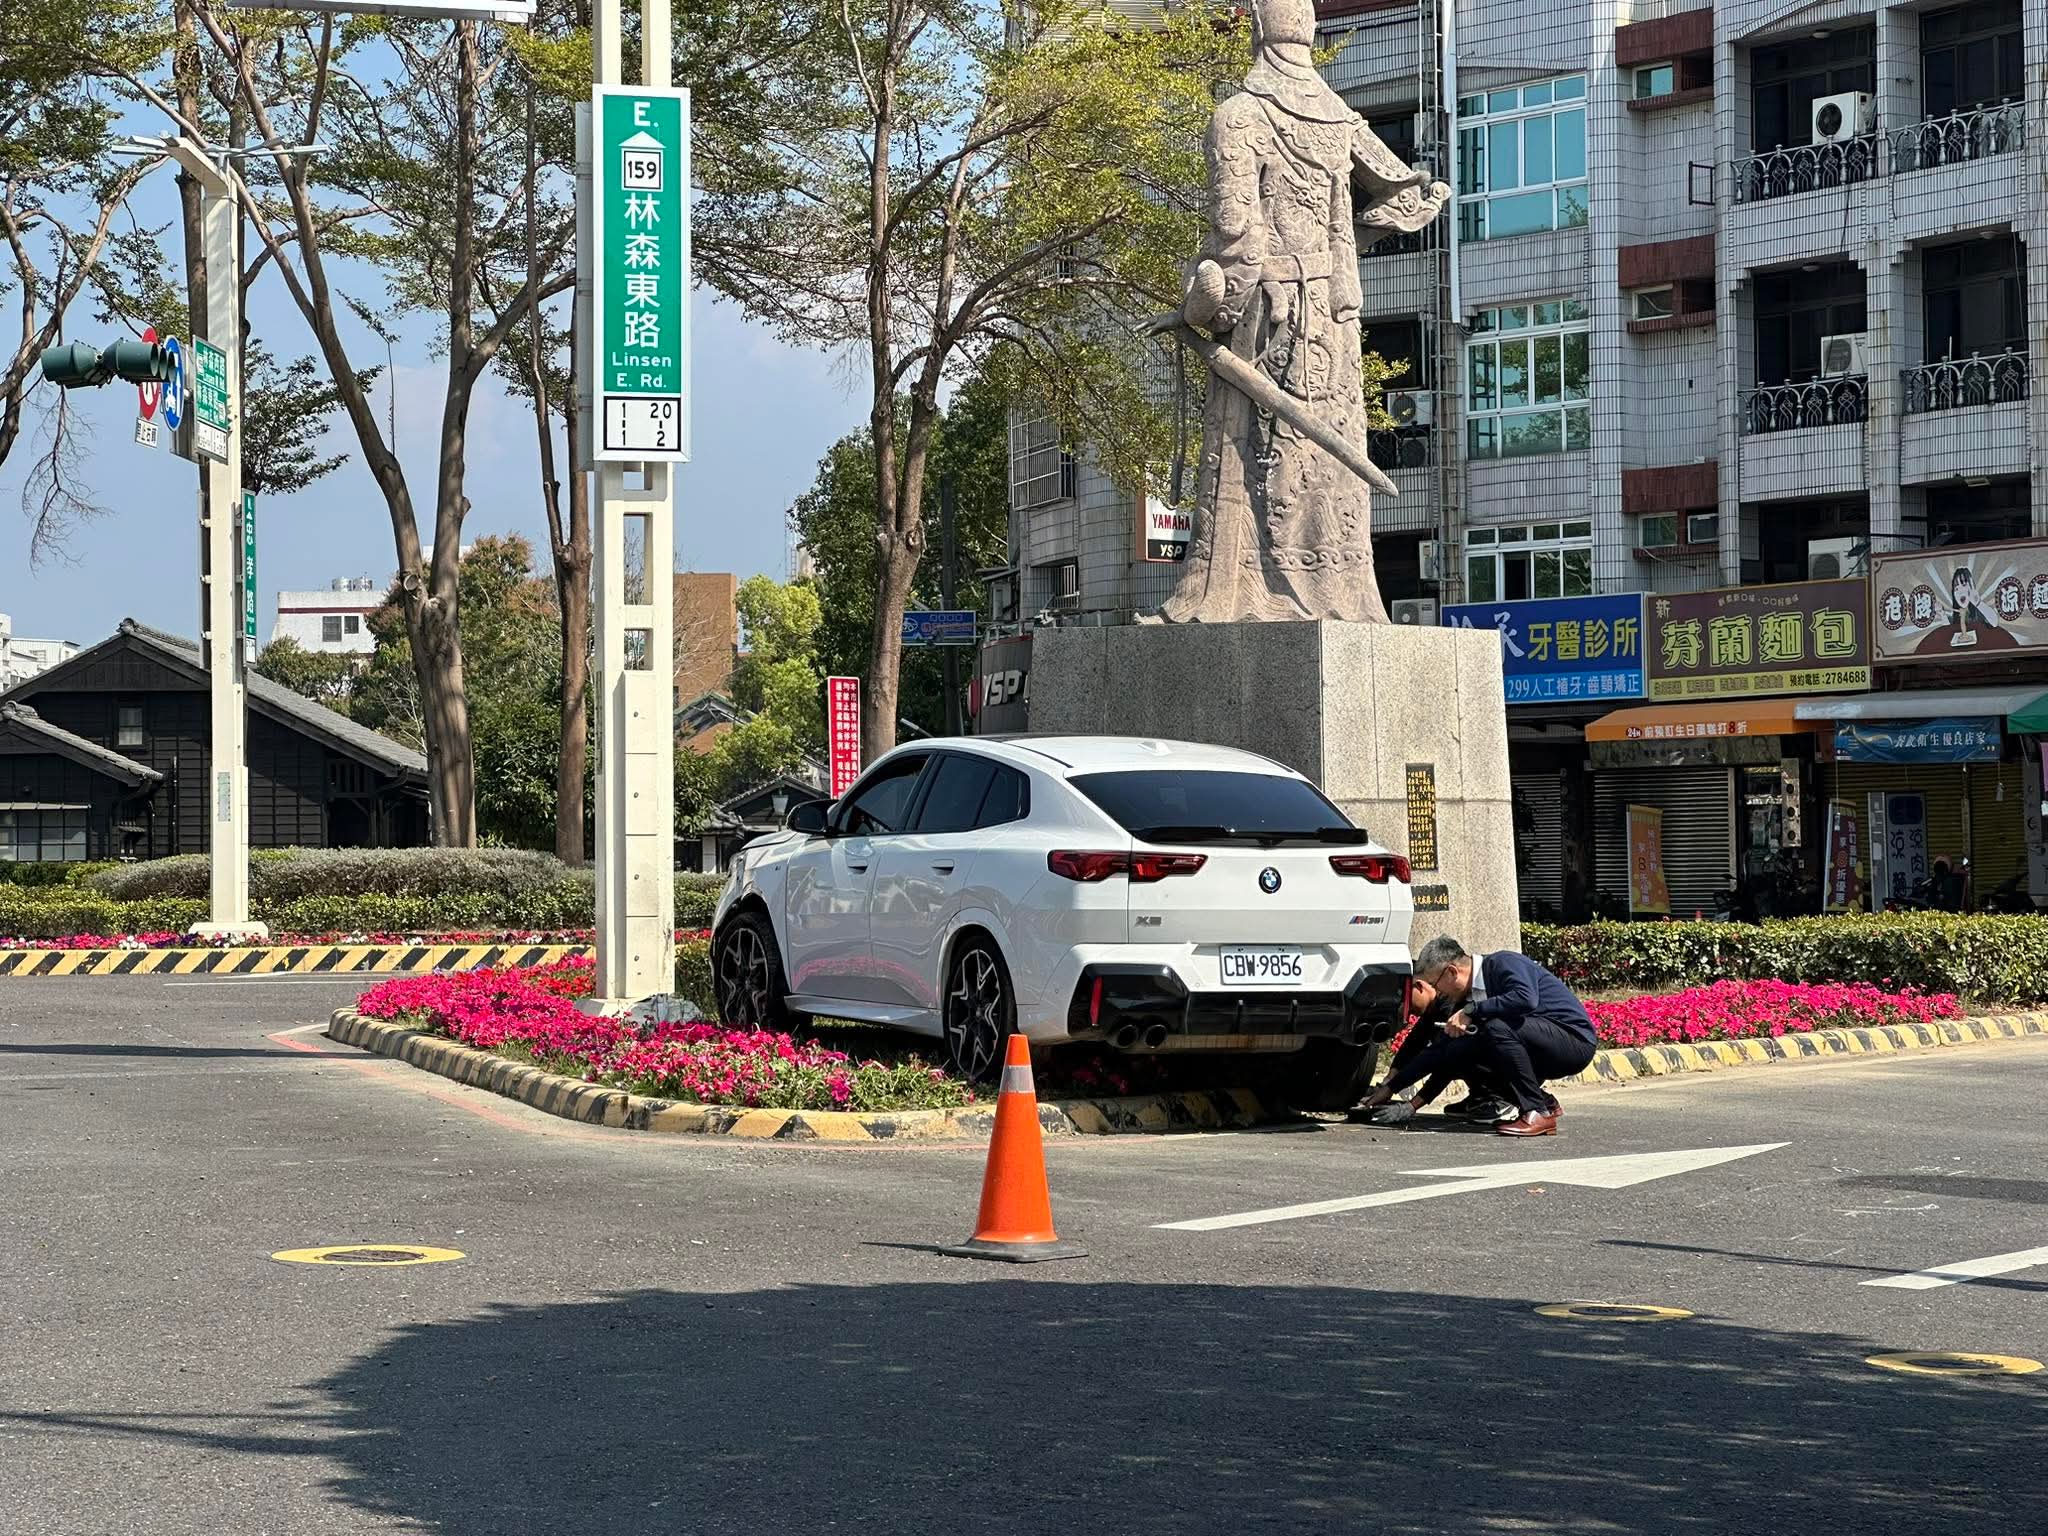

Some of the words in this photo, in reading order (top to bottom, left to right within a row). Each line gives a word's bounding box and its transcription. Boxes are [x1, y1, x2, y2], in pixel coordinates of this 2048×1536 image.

[634, 101, 659, 127] E.
[627, 160, 657, 180] 159
[624, 192, 661, 348] 林森東路
[612, 351, 672, 368] Linsen
[617, 372, 632, 388] E.
[640, 373, 667, 388] Rd.
[1152, 513, 1191, 531] YAMAHA
[1160, 543, 1183, 558] YSP
[1527, 616, 1639, 662] 牙醫診所
[1661, 606, 1858, 670] 芬蘭麵包
